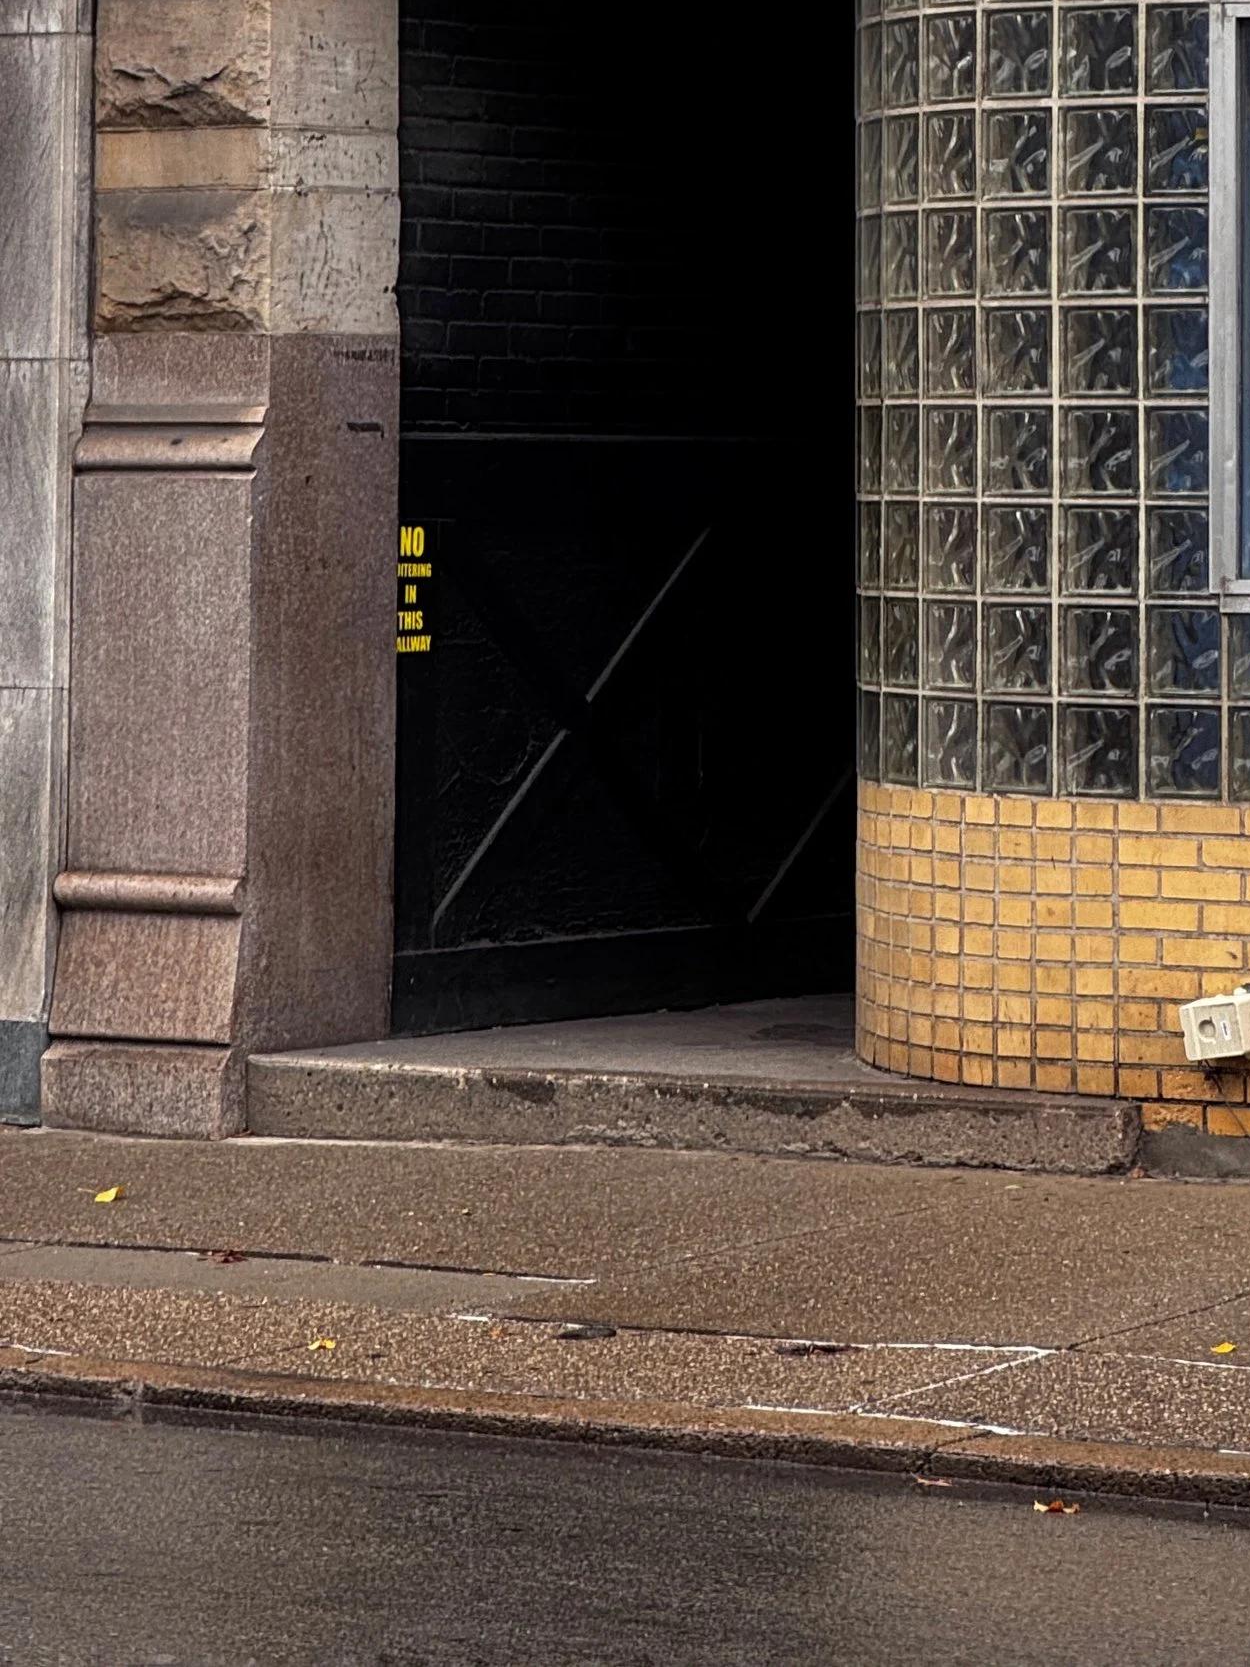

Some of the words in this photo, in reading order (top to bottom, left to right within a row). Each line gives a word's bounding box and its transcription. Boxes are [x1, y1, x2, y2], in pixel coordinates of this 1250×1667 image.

[400, 526, 425, 557] NO
[397, 562, 432, 578] ITERING
[405, 584, 417, 604] IN
[398, 610, 424, 631] THIS
[396, 635, 432, 653] ALLWAY
